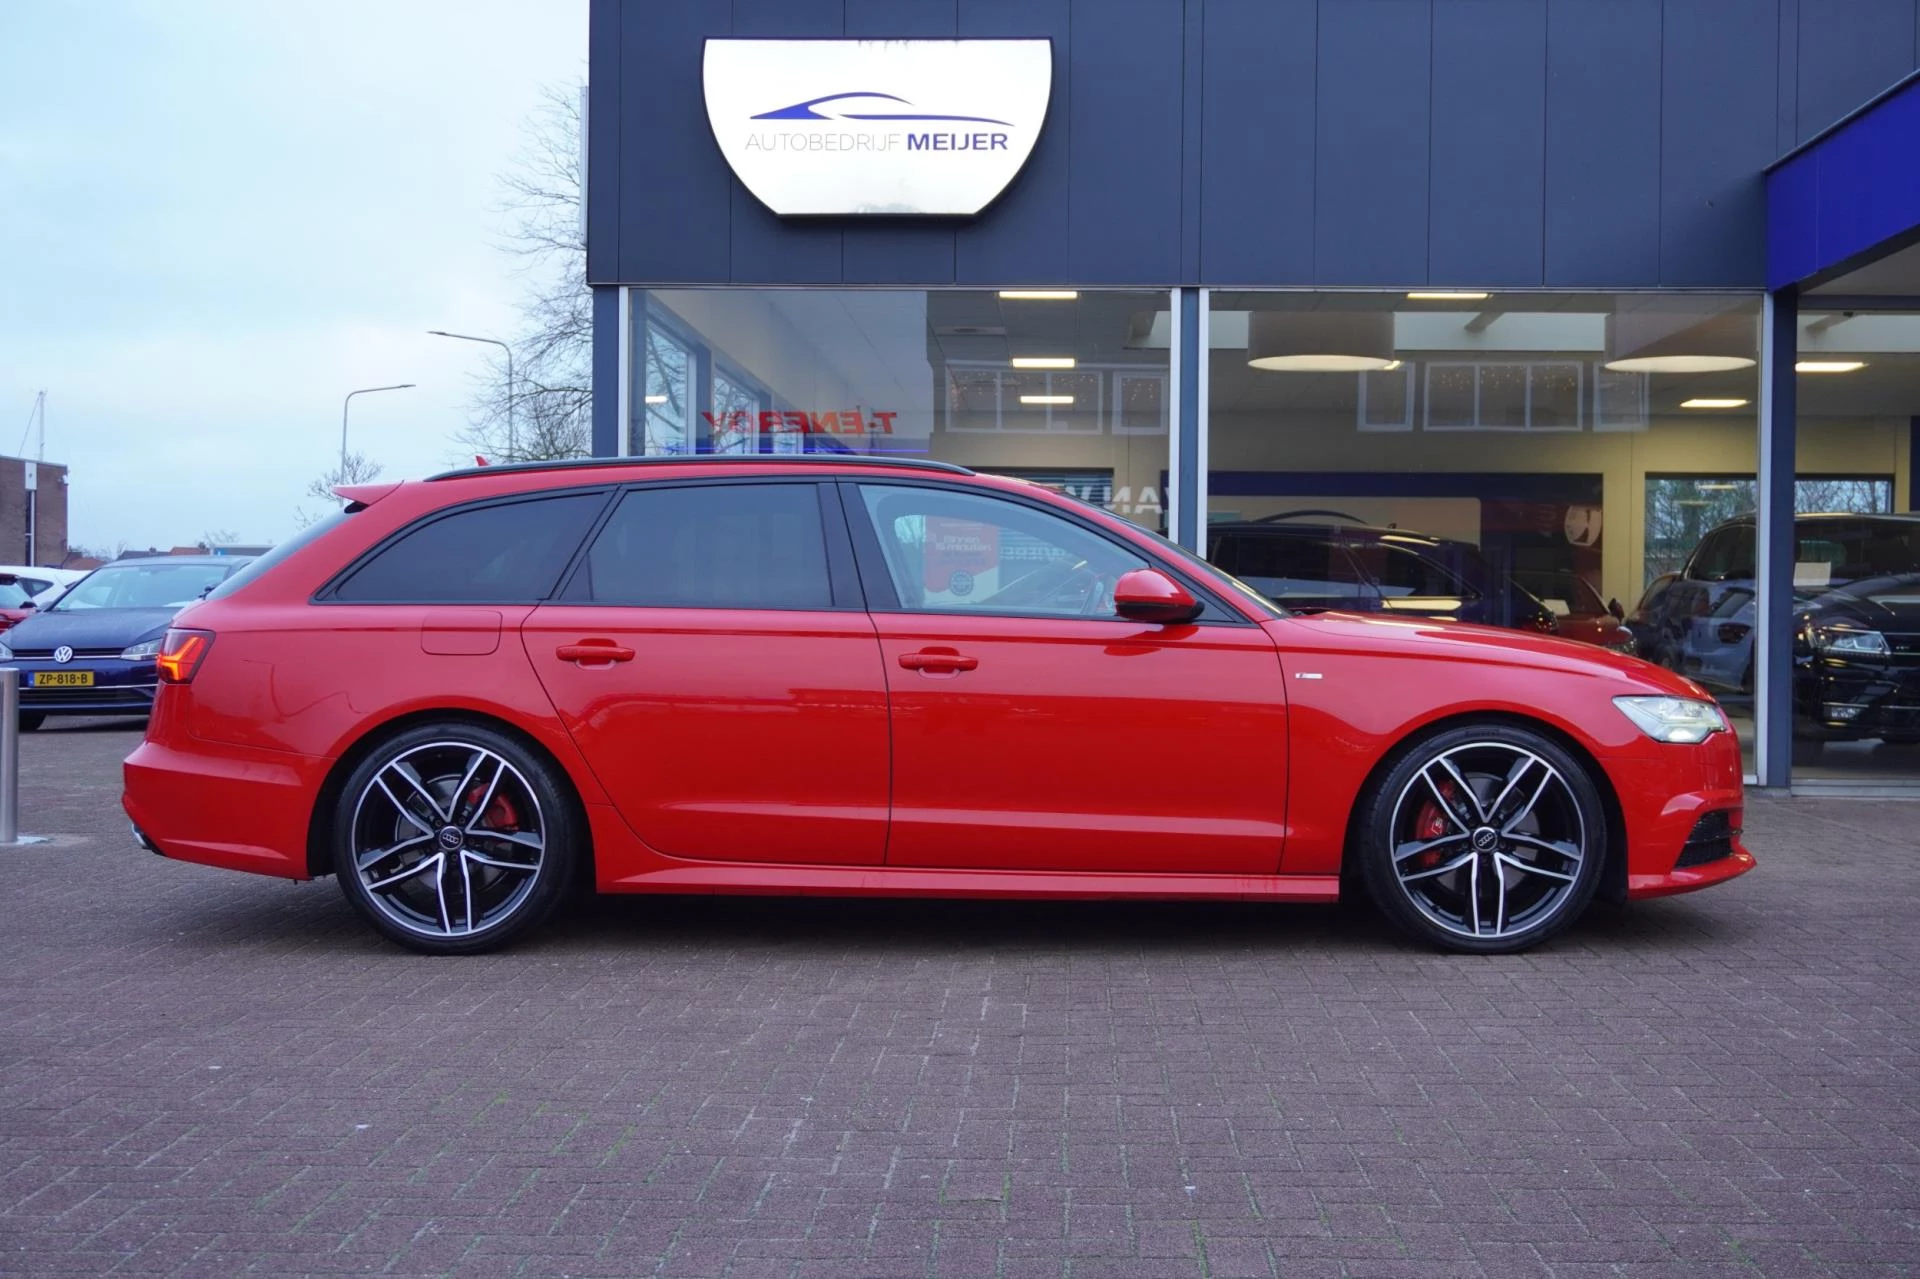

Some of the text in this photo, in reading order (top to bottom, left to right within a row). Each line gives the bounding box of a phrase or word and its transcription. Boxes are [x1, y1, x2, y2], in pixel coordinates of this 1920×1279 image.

[744, 133, 1008, 151] AUTOBEDRIJF MEIJER
[39, 673, 88, 685] ZP-818-B
